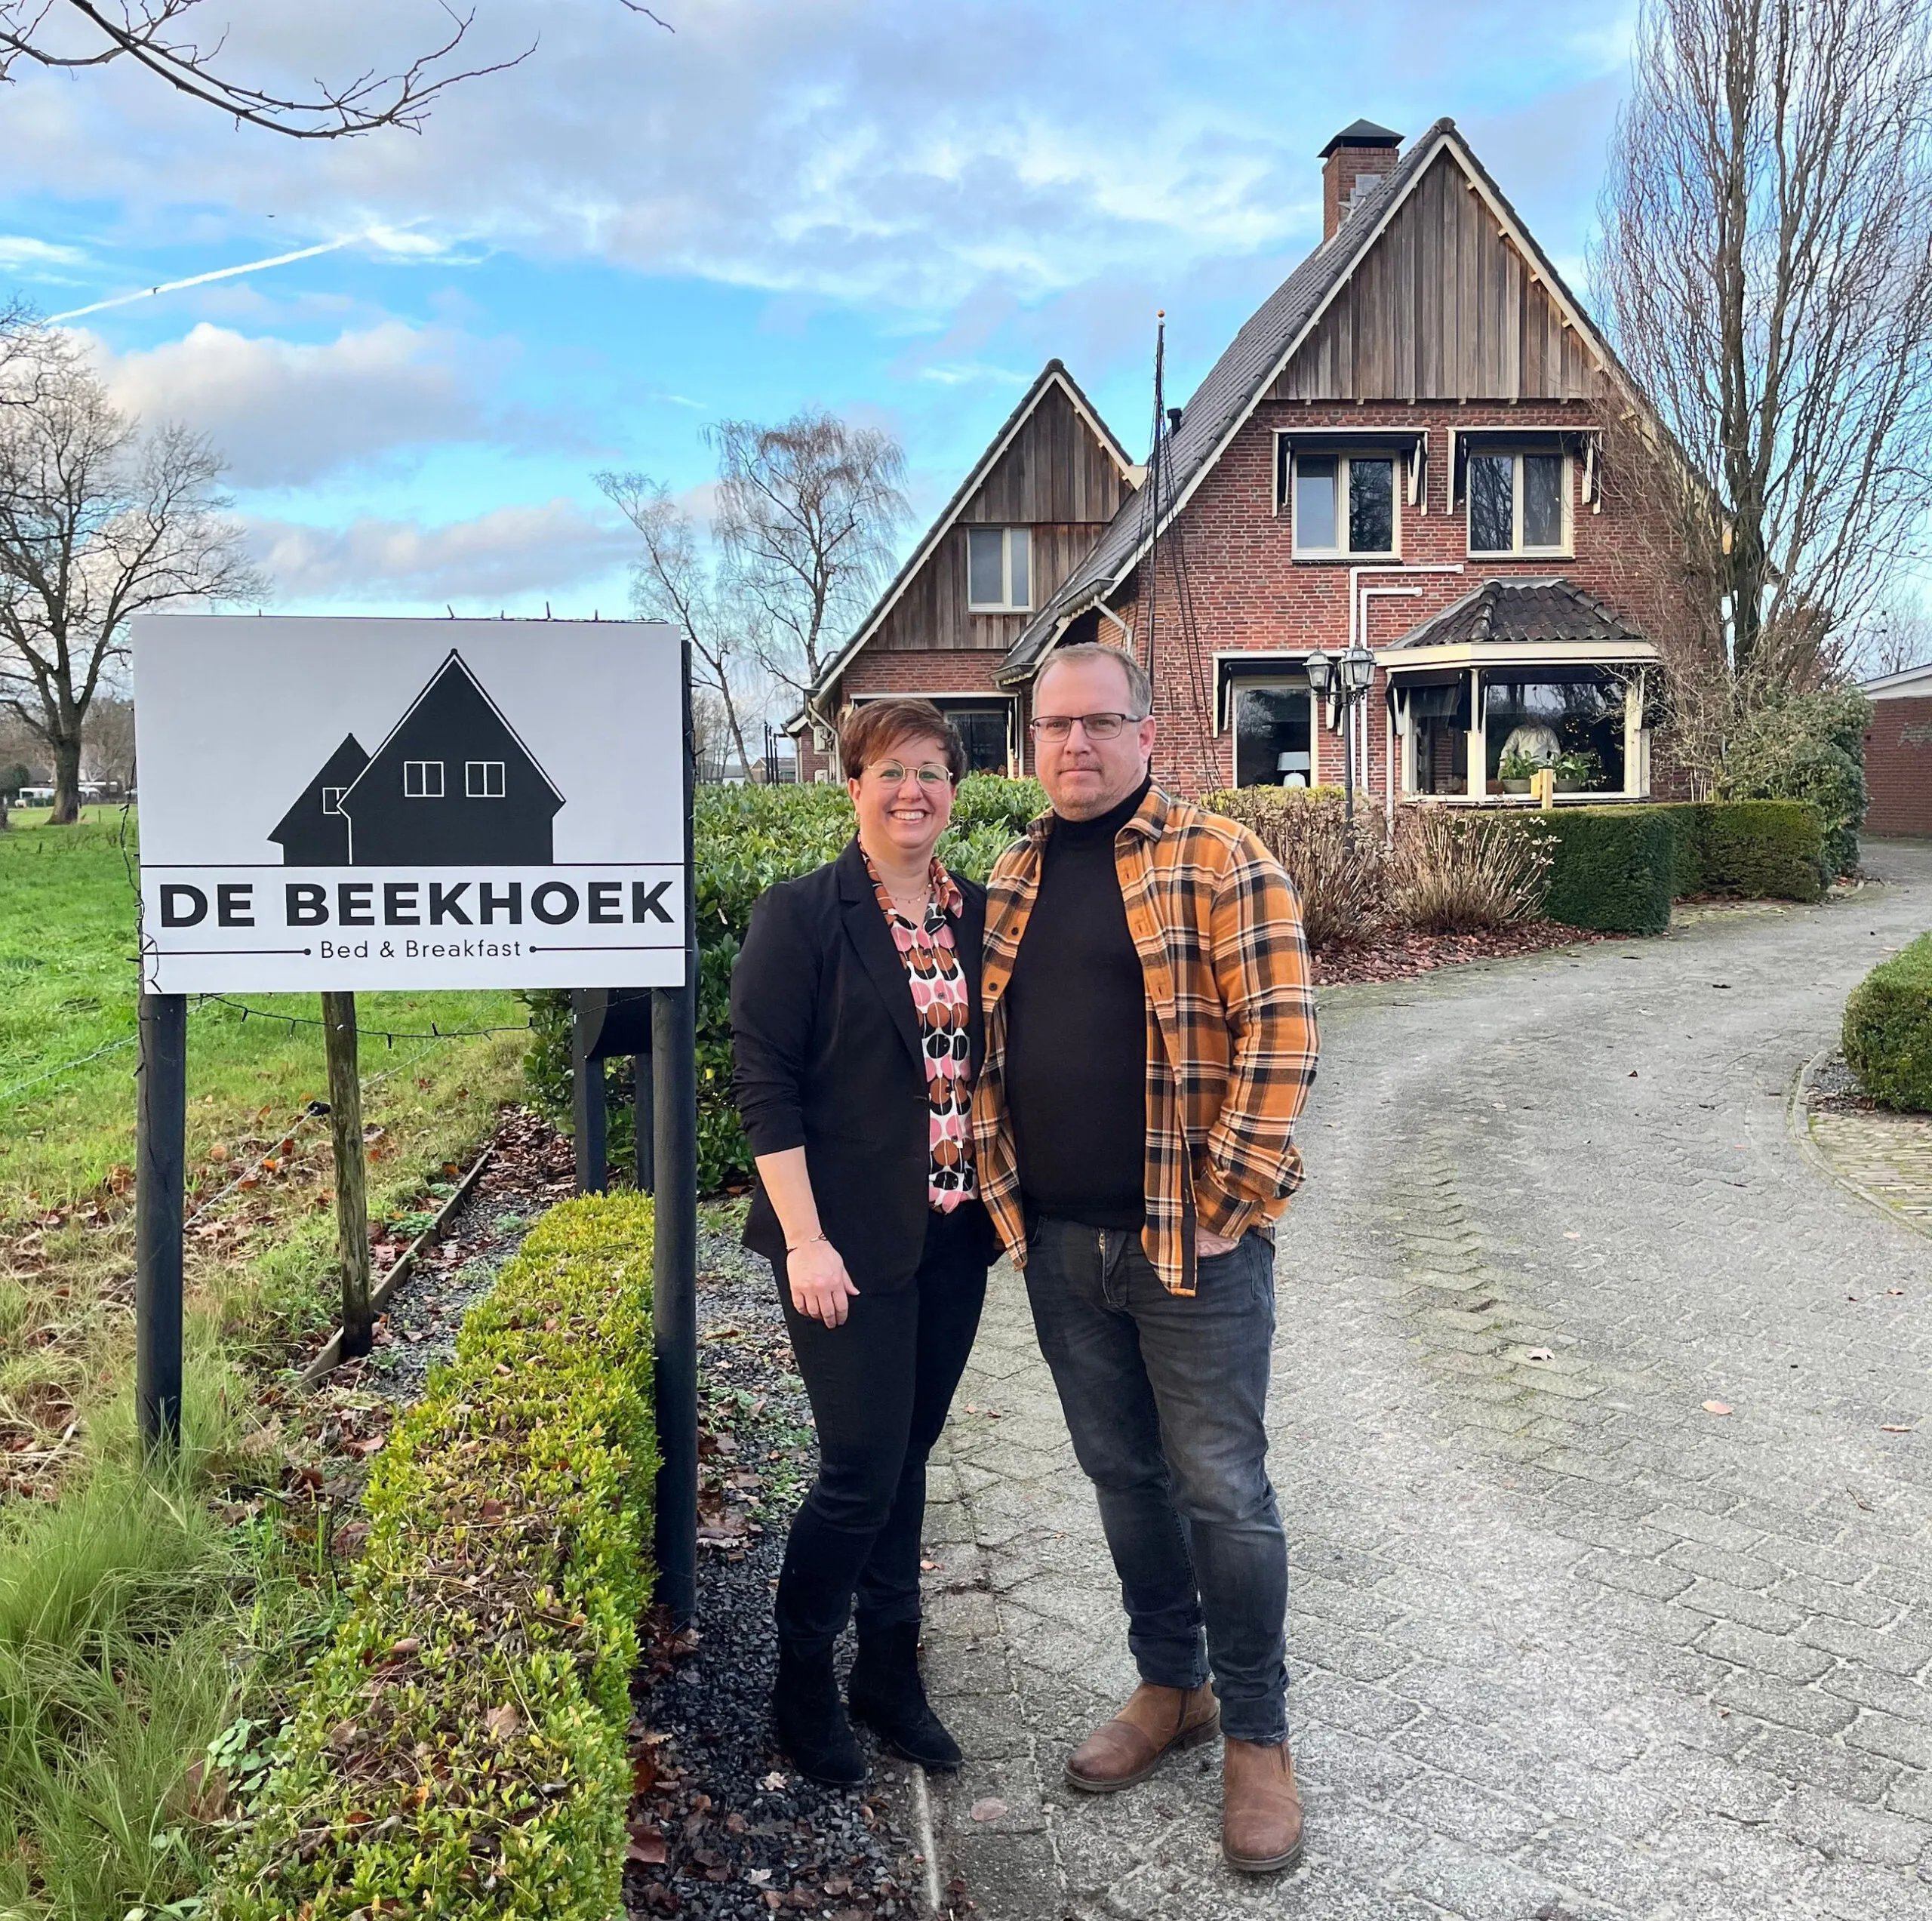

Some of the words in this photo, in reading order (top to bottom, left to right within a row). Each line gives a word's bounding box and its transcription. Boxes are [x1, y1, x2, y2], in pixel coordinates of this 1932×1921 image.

[159, 883, 255, 928] DE
[285, 881, 675, 927] BEEKHOEK
[321, 940, 368, 959] Bed
[380, 940, 395, 958] &
[406, 939, 521, 958] Breakfast
